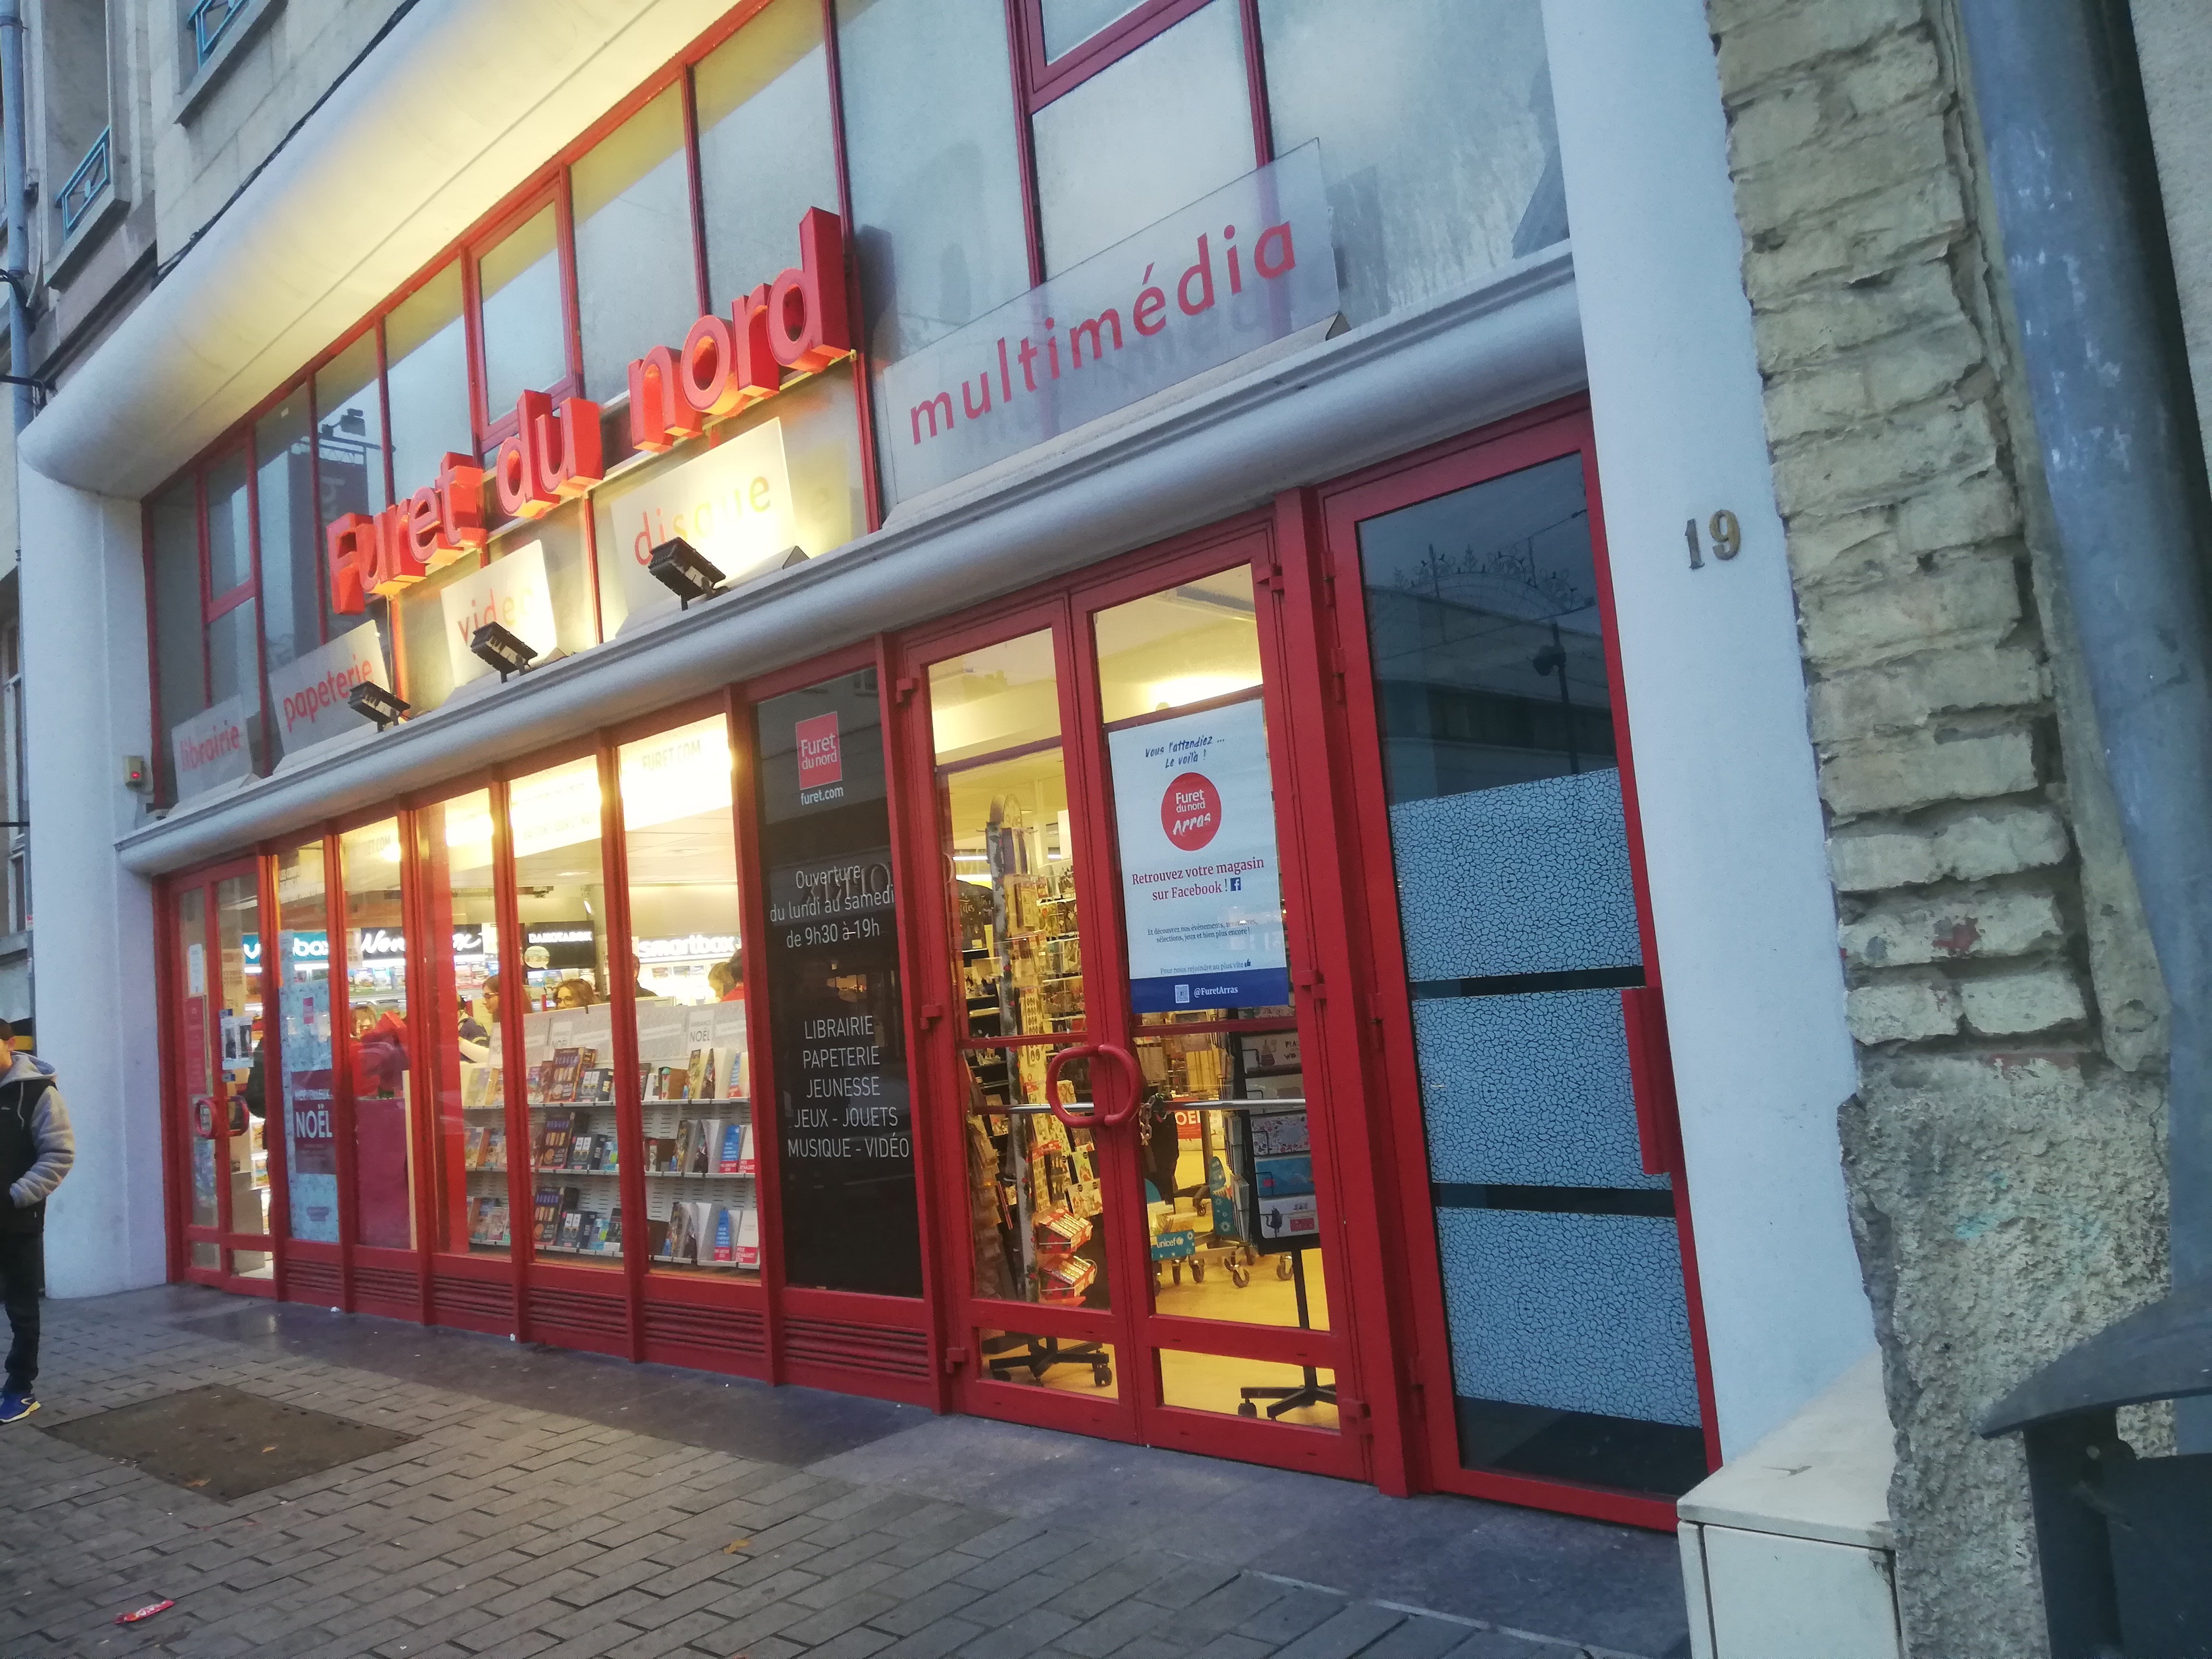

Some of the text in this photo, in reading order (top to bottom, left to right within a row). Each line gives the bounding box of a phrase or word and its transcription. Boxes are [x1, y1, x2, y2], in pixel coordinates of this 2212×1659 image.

[910, 221, 1296, 445] multimédia
[327, 452, 487, 615] Furet
[497, 390, 605, 519] du
[628, 206, 851, 453] nord
[1684, 508, 1741, 569] 19
[282, 653, 374, 733] papeterie
[801, 733, 836, 757] Furet
[1169, 735, 1213, 753] l'attendiez
[802, 750, 837, 769] du nord
[1165, 757, 1174, 769] Le
[1178, 751, 1198, 765] voilà
[801, 786, 843, 805] furet.com
[1176, 790, 1204, 805] Furet
[1176, 800, 1205, 813] du nord
[1172, 813, 1211, 836] Arras
[796, 865, 861, 889] Ouverture
[1132, 856, 1265, 885] Retrouvez votre magasin
[1152, 890, 1169, 901] sur
[1171, 881, 1222, 898] Facebook
[770, 904, 785, 922] du
[789, 897, 820, 919] lundi
[825, 898, 840, 914] au
[845, 884, 894, 911] samedi
[787, 918, 880, 949] de 9h30 à 19h
[1156, 935, 1184, 943] sélections,
[1216, 930, 1227, 939] plus
[1228, 928, 1247, 936] encore
[639, 934, 735, 958] smartbox
[1187, 964, 1212, 974] rejoindre
[1220, 962, 1232, 971] plus
[1194, 986, 1238, 998] @FuretArras
[804, 1015, 874, 1039] LIBRAIRIE
[803, 1046, 880, 1069] PAPETERIE
[806, 1076, 881, 1098] JEUNESSE
[296, 1103, 333, 1139] NOËL
[794, 1109, 829, 1129] JEUX
[842, 1107, 898, 1128] JOUETS
[788, 1138, 852, 1158] MUSIQUE
[865, 1132, 910, 1158] VIDÉO
[1157, 1238, 1176, 1249] unicef
